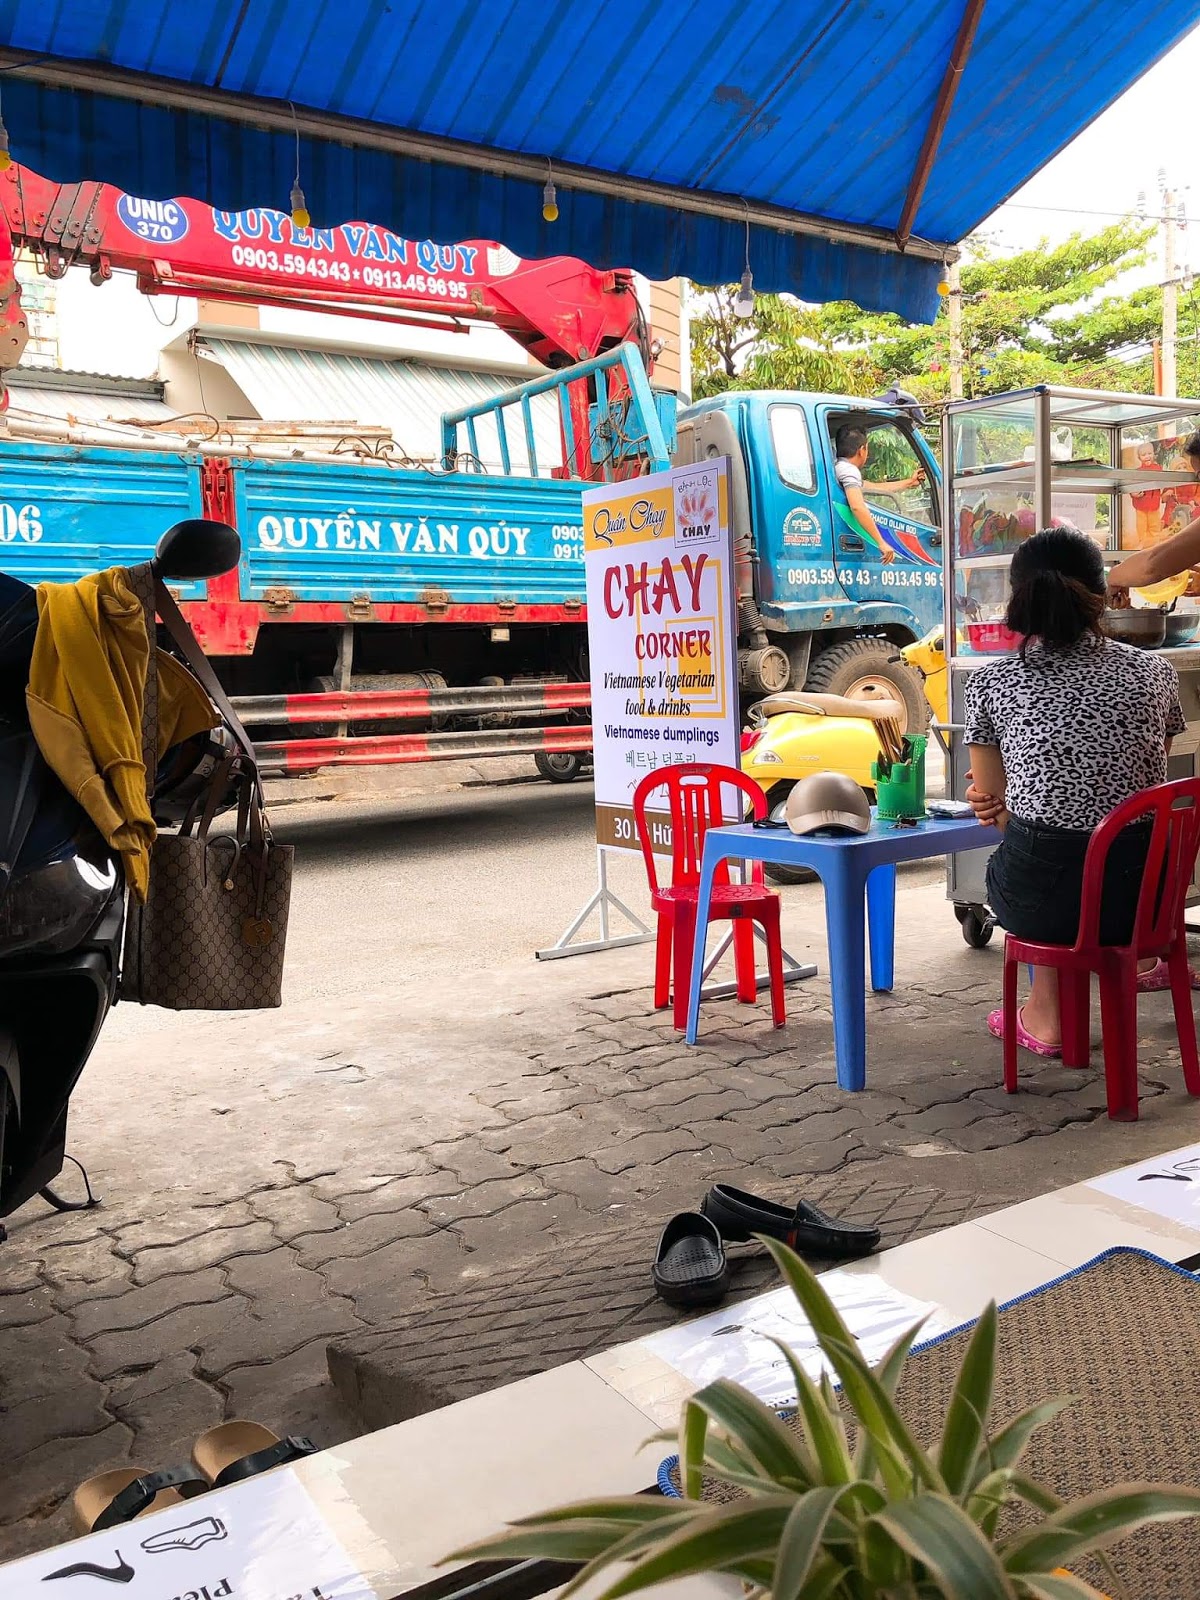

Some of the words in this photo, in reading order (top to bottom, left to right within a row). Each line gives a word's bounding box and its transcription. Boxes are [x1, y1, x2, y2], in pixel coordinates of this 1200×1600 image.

[127, 196, 179, 226] UNIC
[137, 221, 173, 240] 370
[0, 503, 43, 543] 06
[552, 525, 584, 541] 0903
[593, 508, 627, 547] Quán
[629, 500, 667, 537] Chay
[683, 524, 711, 538] CHAY
[390, 515, 460, 555] VĂN
[603, 553, 709, 619] CHAY
[788, 569, 835, 585] 0903.59
[839, 569, 854, 585] 43
[856, 570, 870, 586] 43
[924, 572, 937, 587] 96
[635, 630, 712, 660] CORNER
[604, 672, 657, 689] Vietnamese
[658, 669, 716, 693] Vegetarian
[625, 699, 646, 716] food
[648, 699, 656, 716] &
[658, 699, 691, 716] drinks
[604, 724, 660, 740] Vietnamese
[663, 726, 720, 747] dumplings
[626, 750, 658, 769] 베트남
[614, 817, 631, 839] 30
